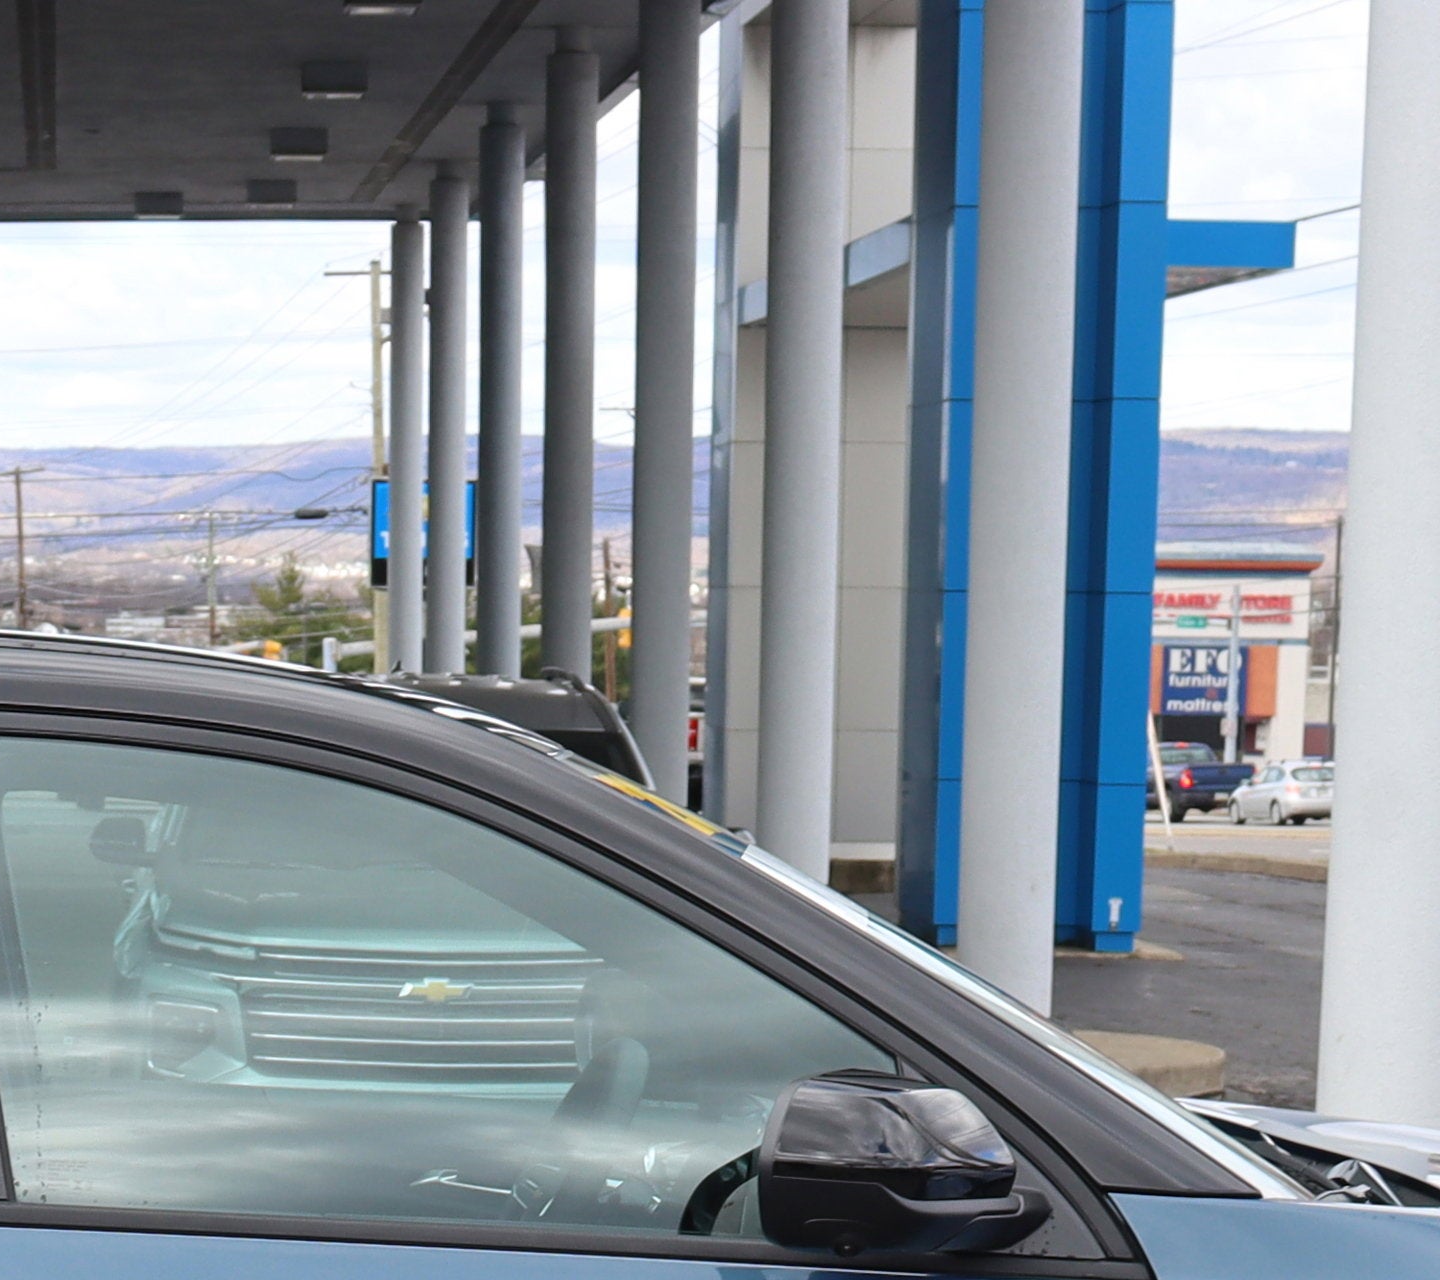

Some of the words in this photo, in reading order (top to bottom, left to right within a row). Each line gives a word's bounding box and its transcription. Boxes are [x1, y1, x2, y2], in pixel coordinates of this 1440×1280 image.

[1232, 595, 1292, 611] TORE
[1168, 673, 1230, 688] furnitur
[1166, 698, 1238, 713] mattre
